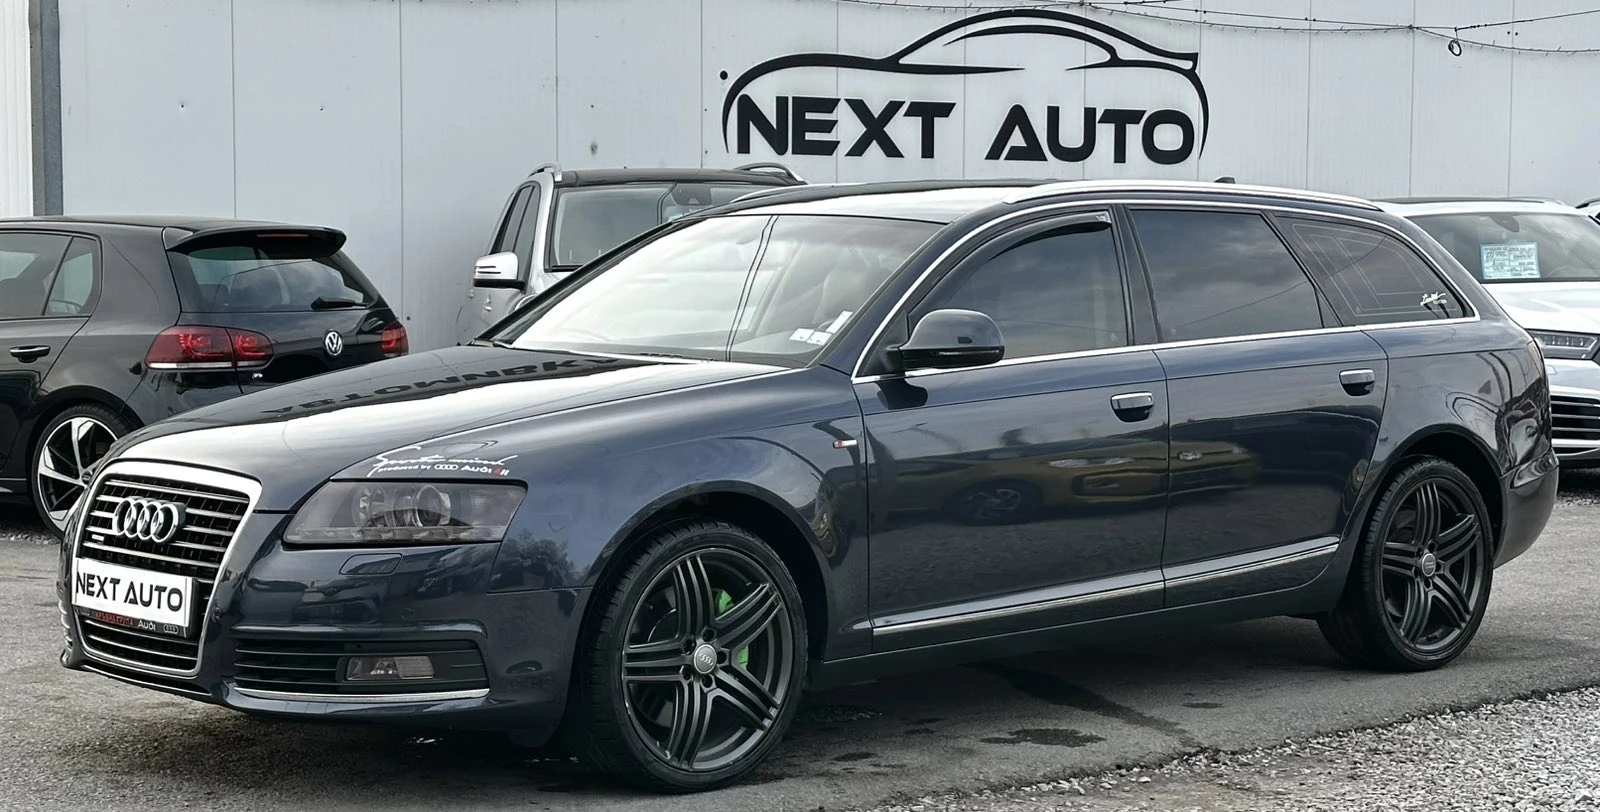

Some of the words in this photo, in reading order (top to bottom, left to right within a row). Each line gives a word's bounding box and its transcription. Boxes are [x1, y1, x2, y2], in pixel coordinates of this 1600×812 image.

[737, 94, 956, 159] NEXT
[985, 104, 1195, 165] AUTO
[378, 465, 418, 473] produced
[76, 572, 121, 601] NEXT
[124, 581, 183, 612] AUTO
